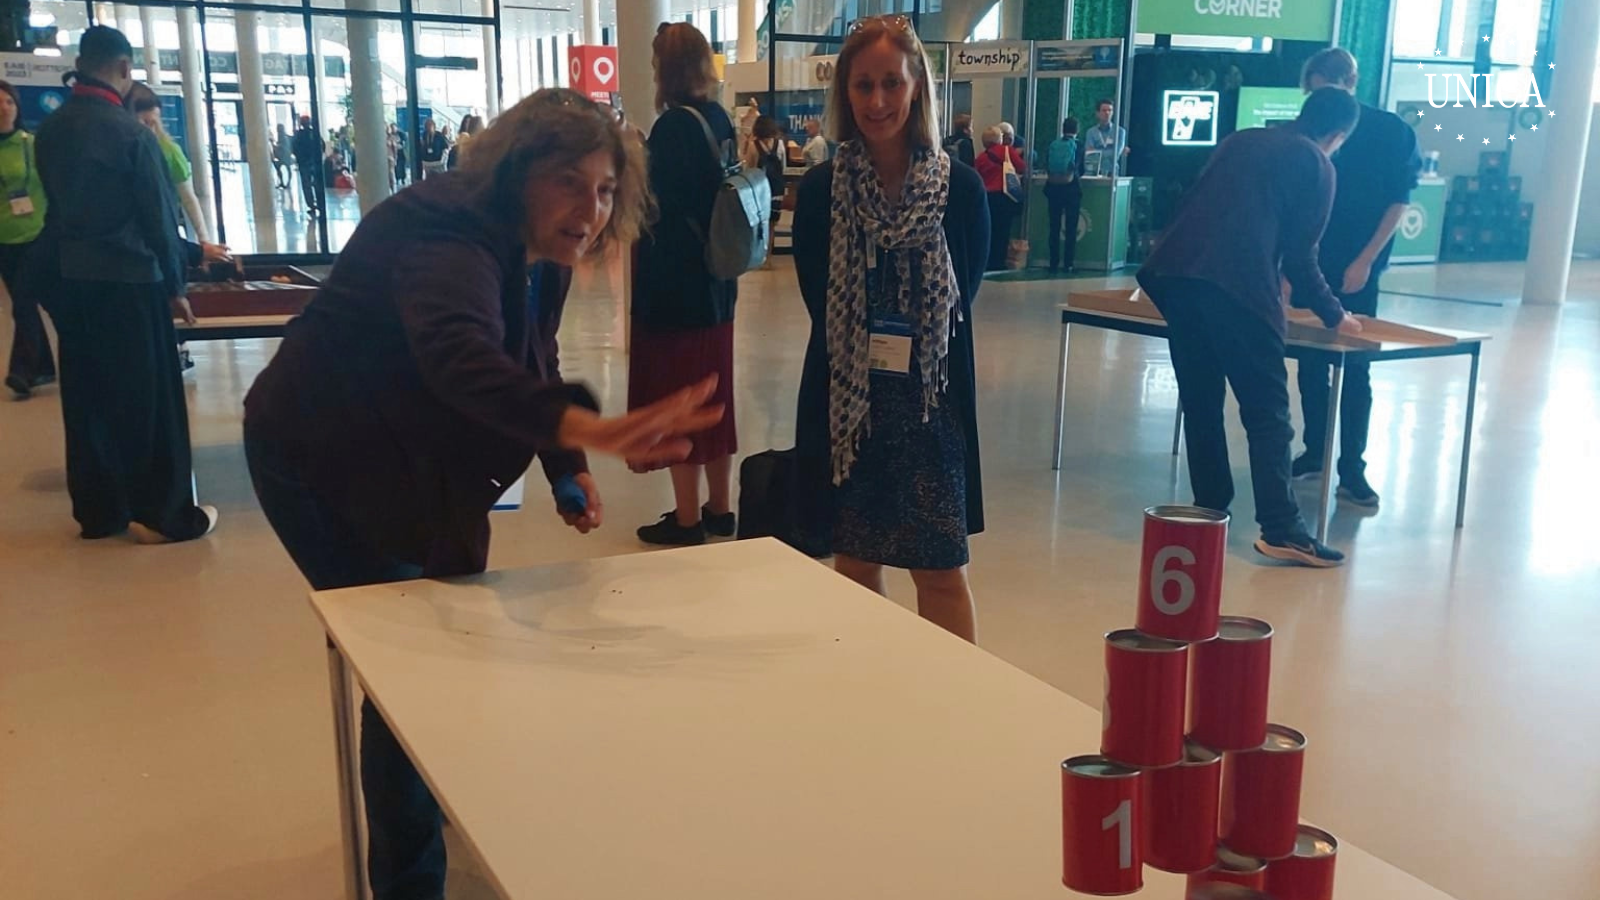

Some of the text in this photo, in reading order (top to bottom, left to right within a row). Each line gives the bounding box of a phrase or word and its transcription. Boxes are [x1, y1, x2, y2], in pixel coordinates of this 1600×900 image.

[1194, 0, 1282, 19] CORNER
[958, 47, 1020, 70] township
[1150, 545, 1197, 616] 6
[1102, 799, 1132, 869] 1
